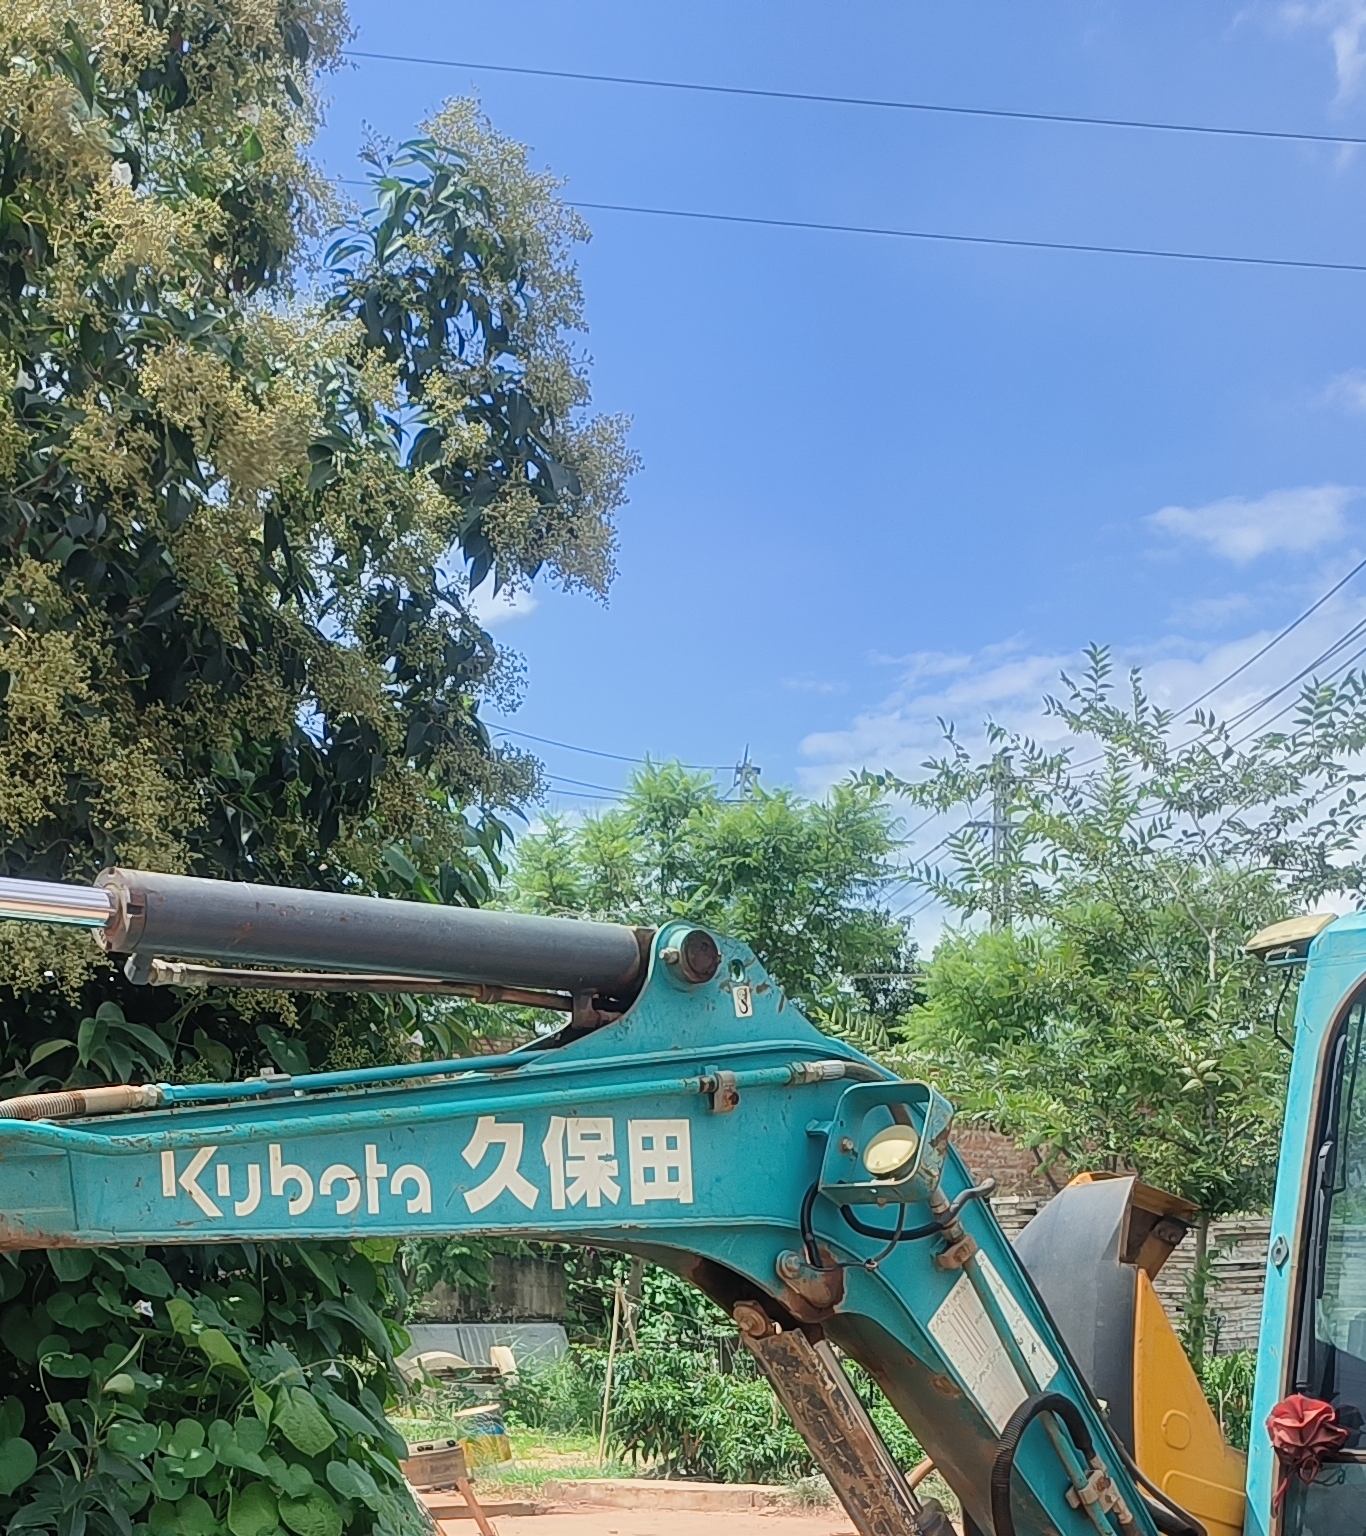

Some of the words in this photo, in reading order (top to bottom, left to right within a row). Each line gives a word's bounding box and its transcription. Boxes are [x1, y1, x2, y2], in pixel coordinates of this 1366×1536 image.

[160, 1143, 432, 1217] Kubota
[461, 1116, 694, 1213] 久保田
